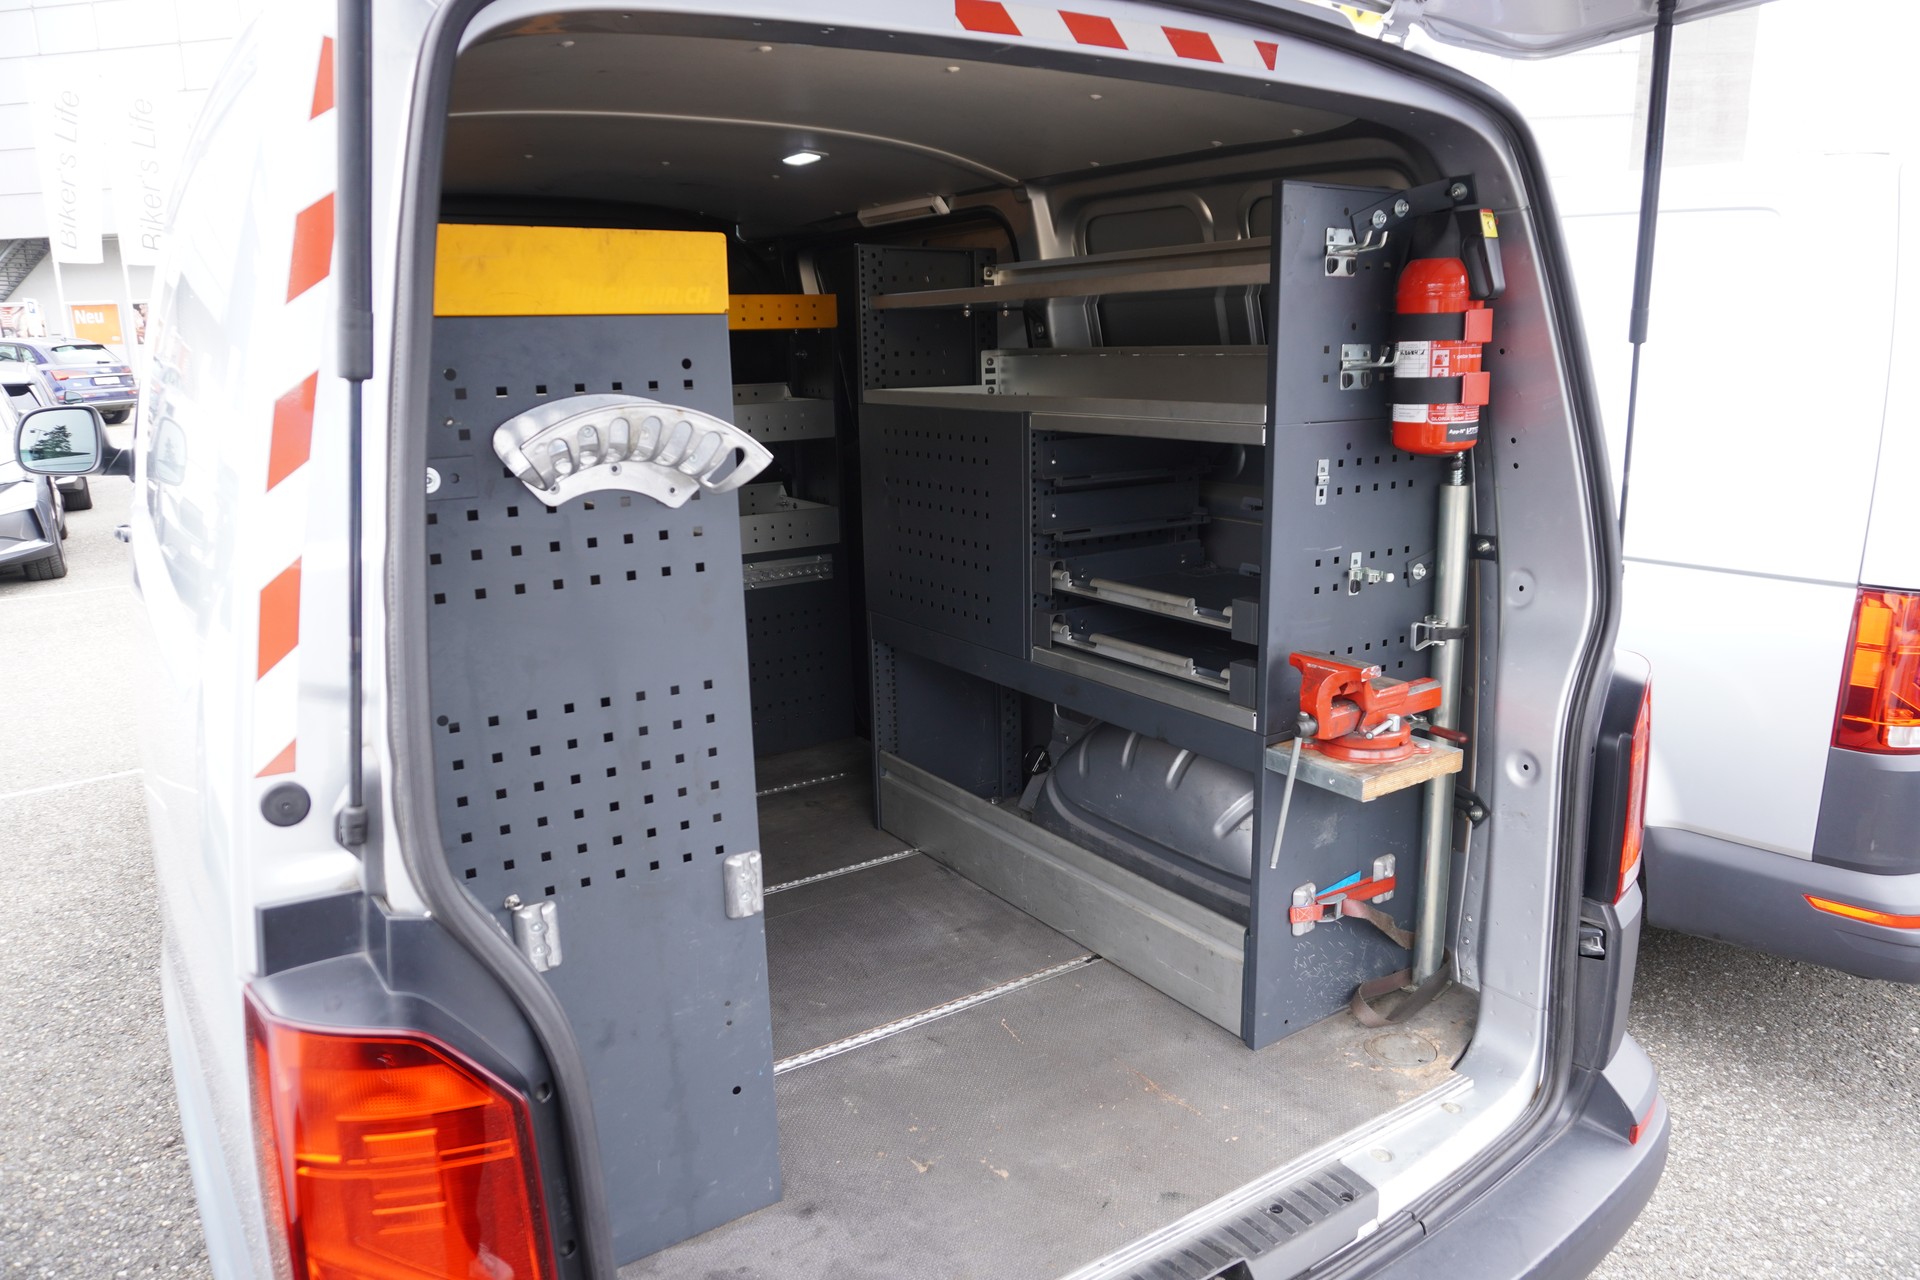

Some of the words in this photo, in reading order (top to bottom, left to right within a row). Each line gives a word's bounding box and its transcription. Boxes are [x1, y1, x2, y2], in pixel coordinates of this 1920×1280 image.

[54, 89, 80, 144] Life
[129, 97, 157, 149] Life
[57, 152, 79, 250] Biker's
[75, 310, 104, 324] Neu
